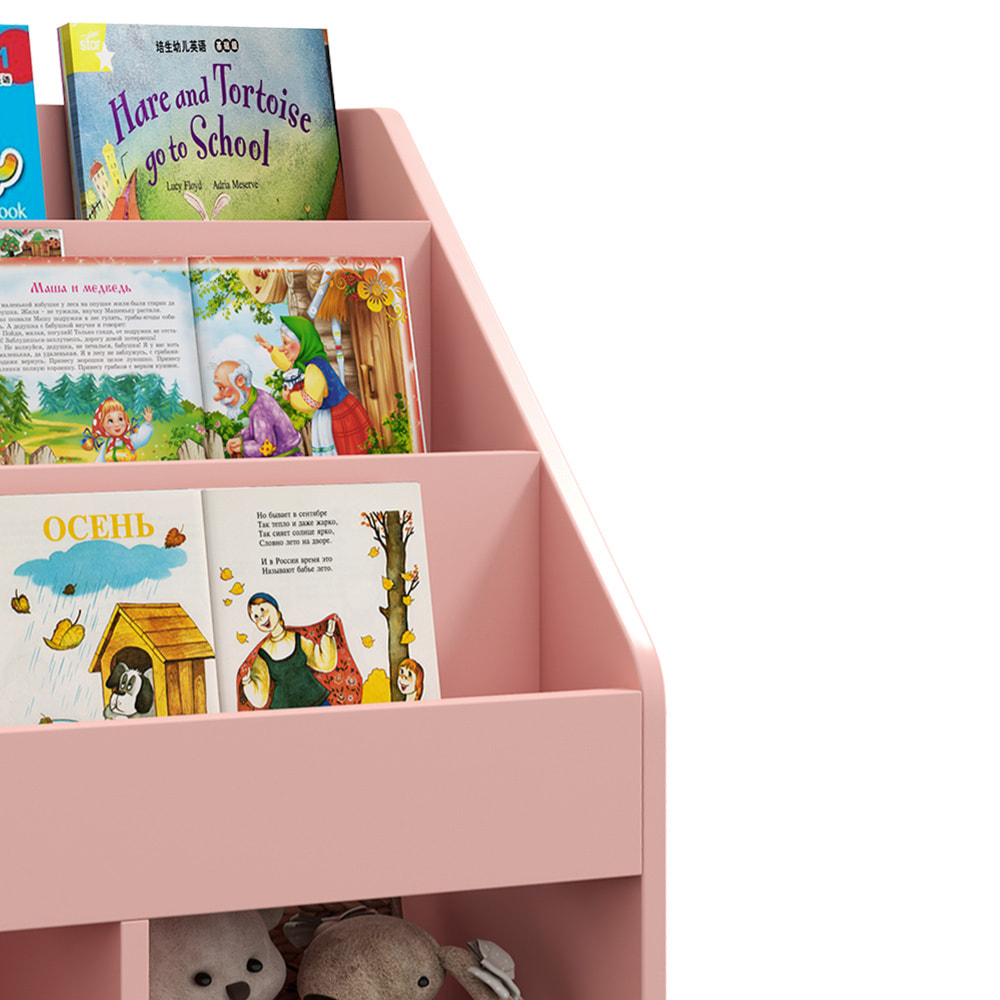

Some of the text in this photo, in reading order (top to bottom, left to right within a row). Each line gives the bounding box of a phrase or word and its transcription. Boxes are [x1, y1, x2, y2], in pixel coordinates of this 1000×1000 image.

[156, 40, 206, 53] 培生幼儿英语
[108, 63, 312, 146] Hare and Tortoise
[146, 114, 270, 186] go to School
[166, 180, 202, 192] Lucy Floyd
[213, 180, 259, 190] Adria Meserve
[30, 282, 132, 294] Маша и медведь
[298, 509, 327, 517] сентябре
[43, 512, 154, 542] ОСЕНЬ
[258, 539, 284, 547] Словно
[296, 565, 315, 573] бабье
